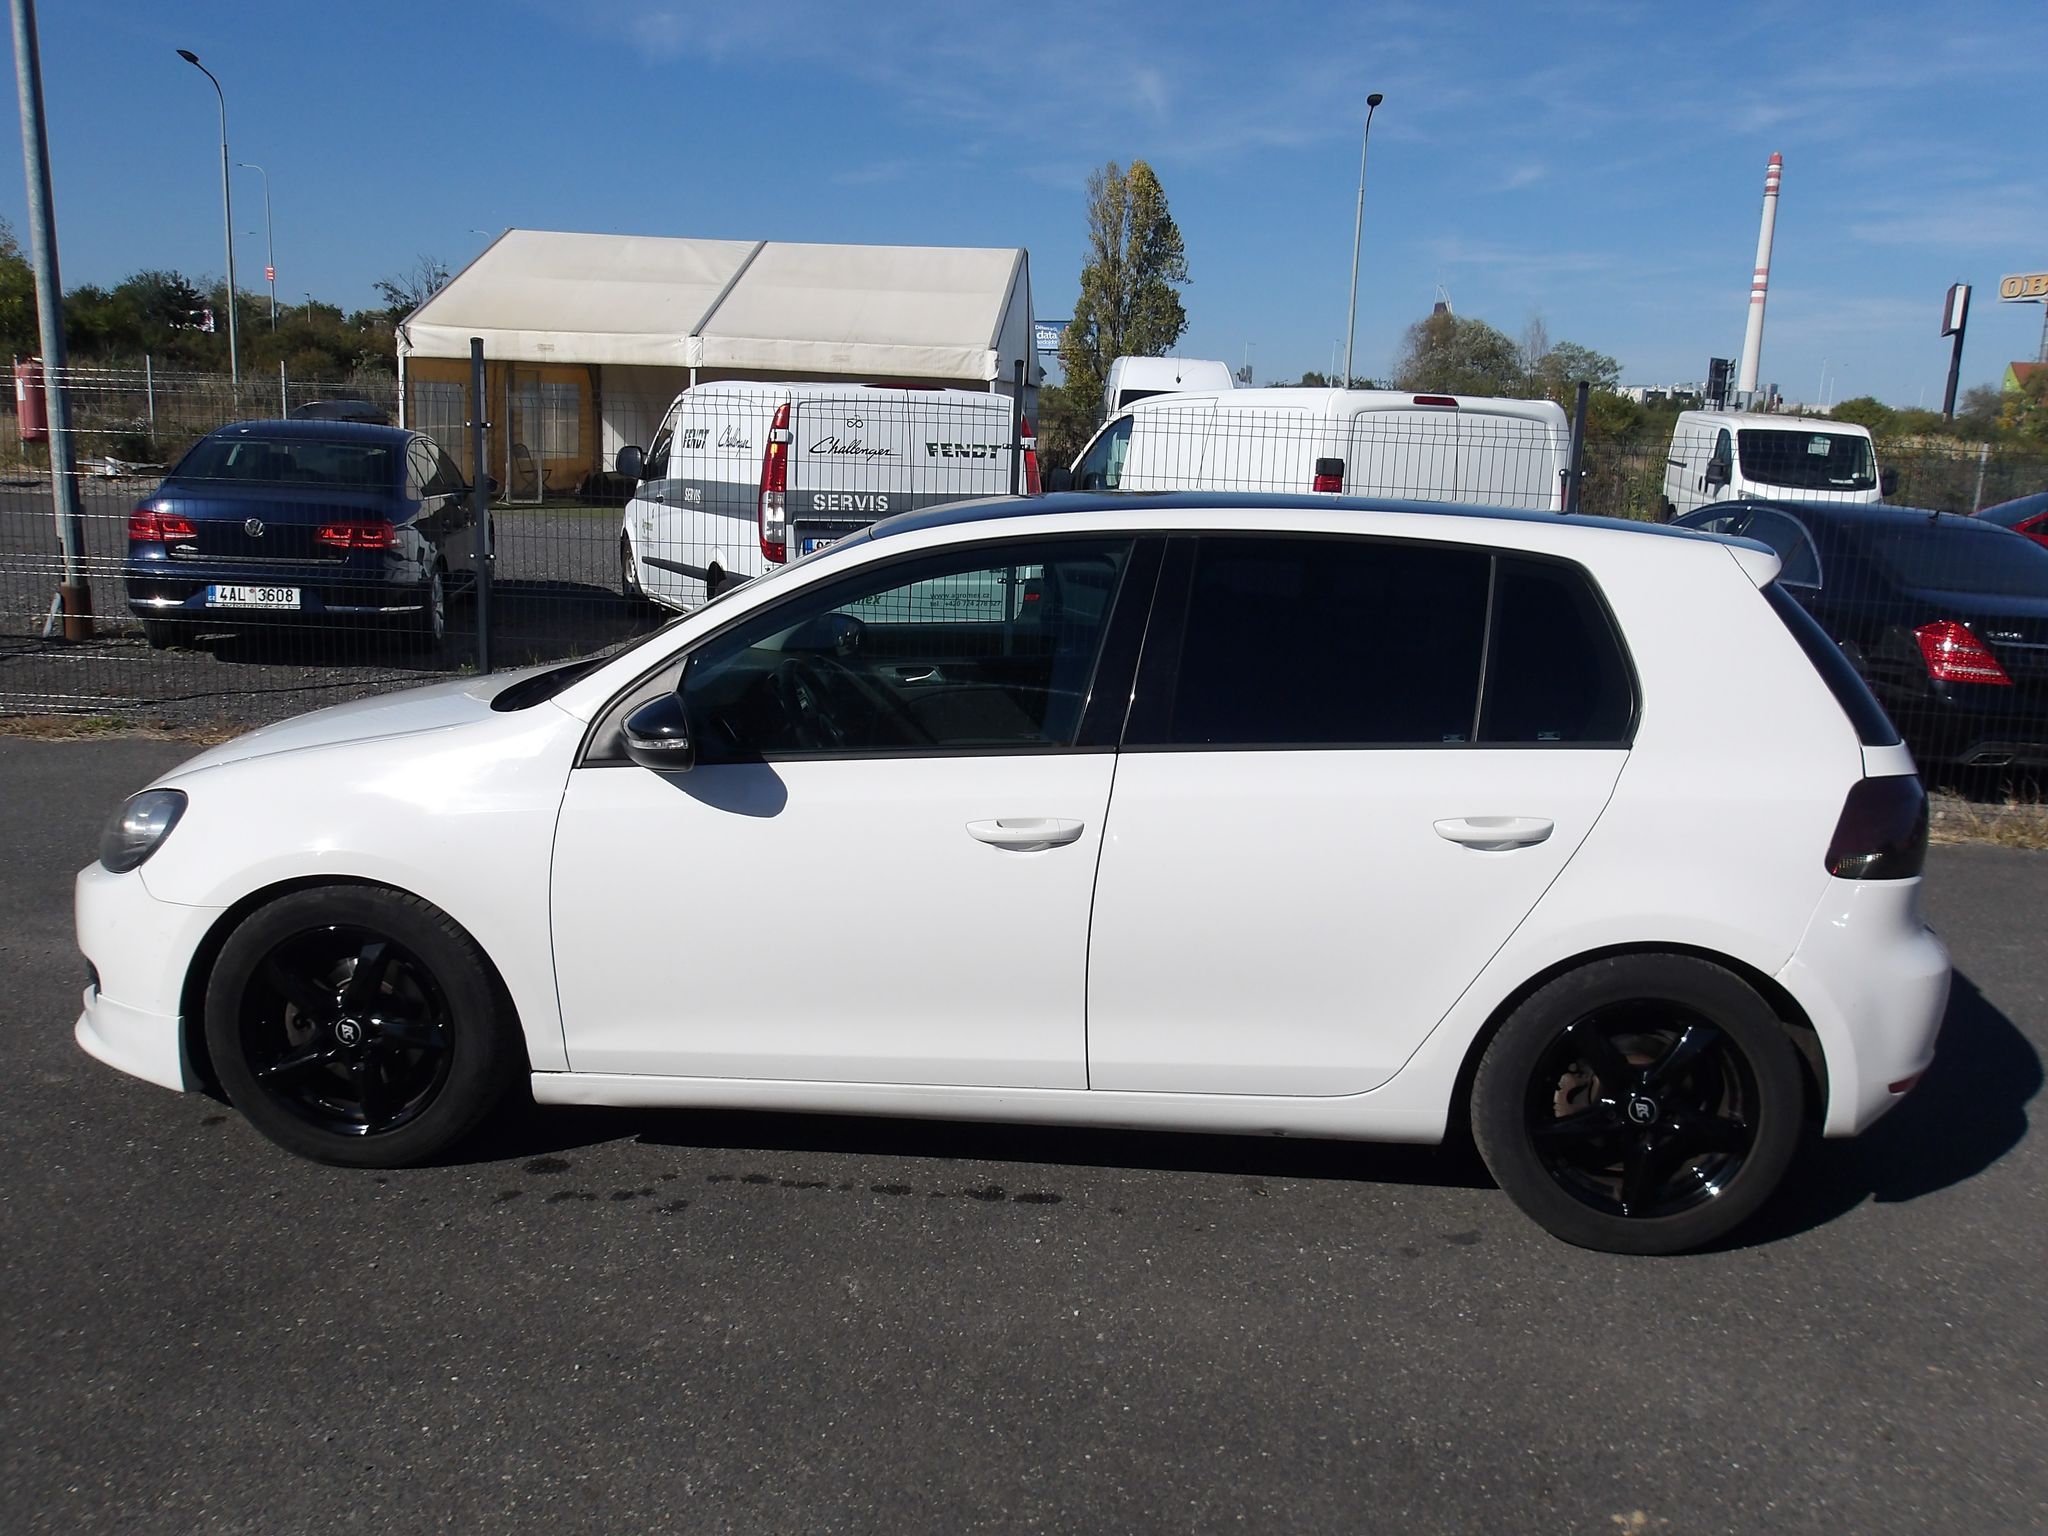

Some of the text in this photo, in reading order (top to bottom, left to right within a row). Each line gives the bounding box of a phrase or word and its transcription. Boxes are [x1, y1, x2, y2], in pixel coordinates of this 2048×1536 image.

[1036, 331, 1057, 340] data
[683, 429, 710, 449] FENDT
[809, 437, 894, 461] Challenger
[926, 442, 1002, 459] FENDT
[684, 488, 702, 504] SERVIS
[813, 494, 889, 512] SERVIS
[220, 587, 293, 602] 4AL 3608
